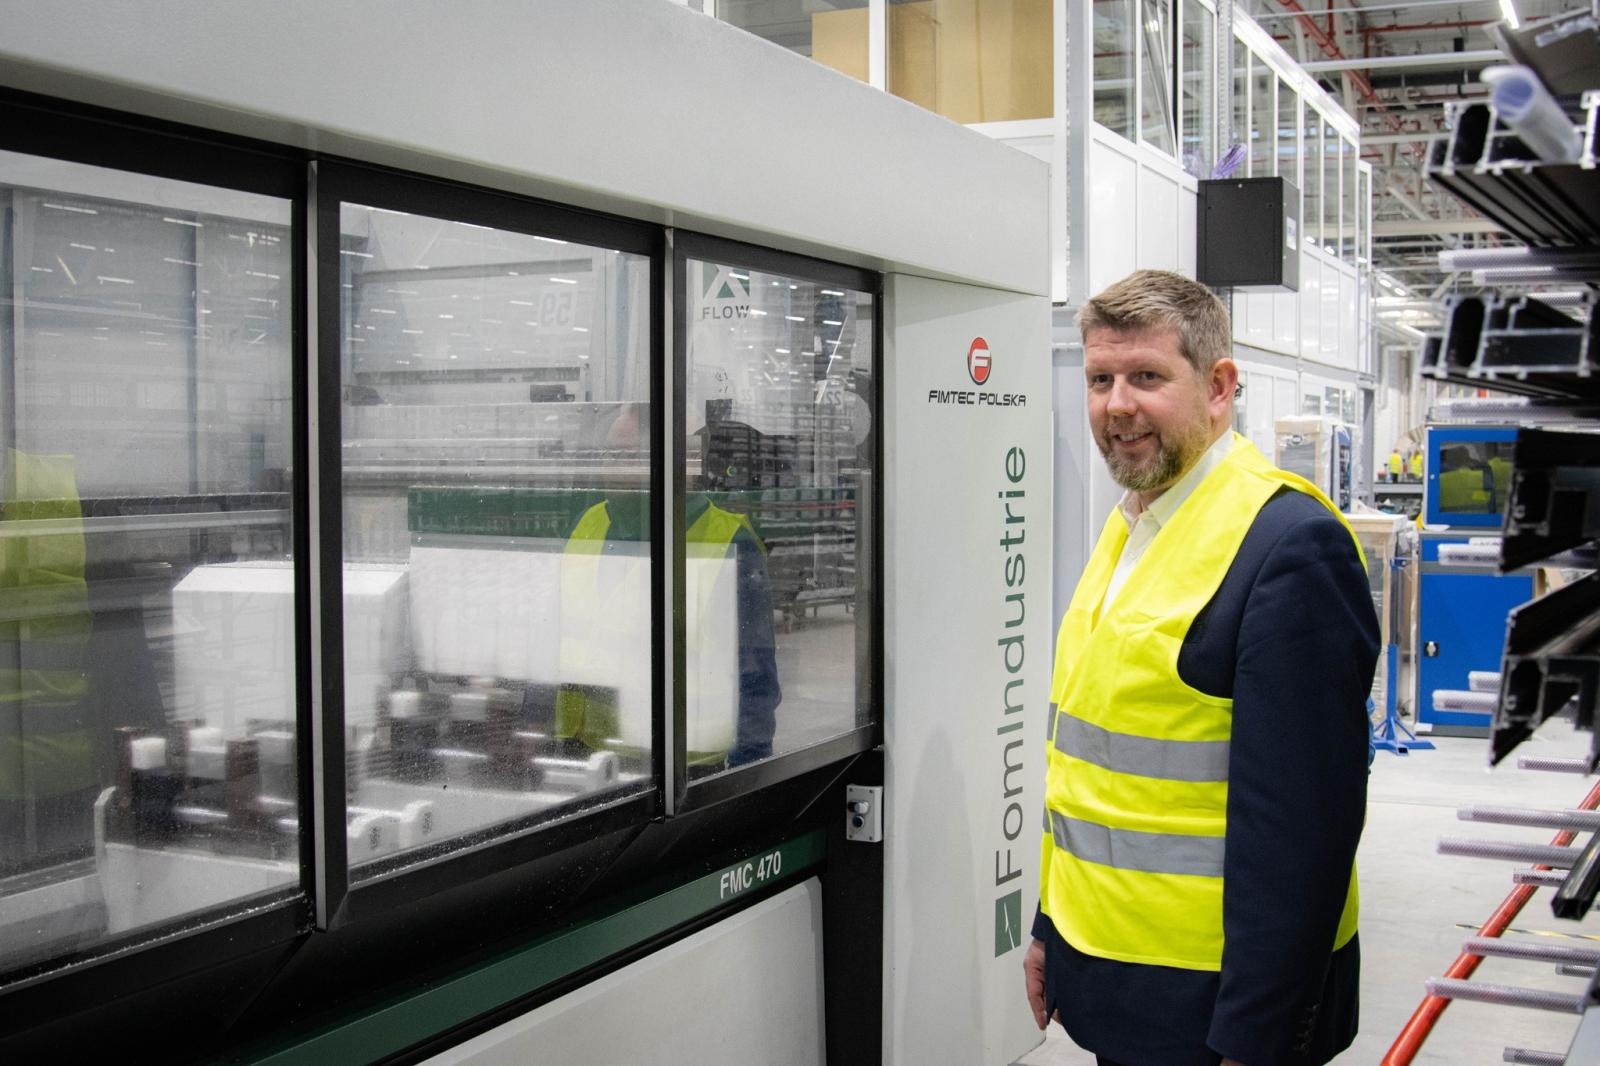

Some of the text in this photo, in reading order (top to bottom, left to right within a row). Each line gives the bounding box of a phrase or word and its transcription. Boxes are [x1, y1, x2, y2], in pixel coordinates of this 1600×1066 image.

[702, 305, 750, 320] FLOW
[928, 390, 1026, 407] FIMTEC POLSKA
[720, 850, 781, 899] FMC 470
